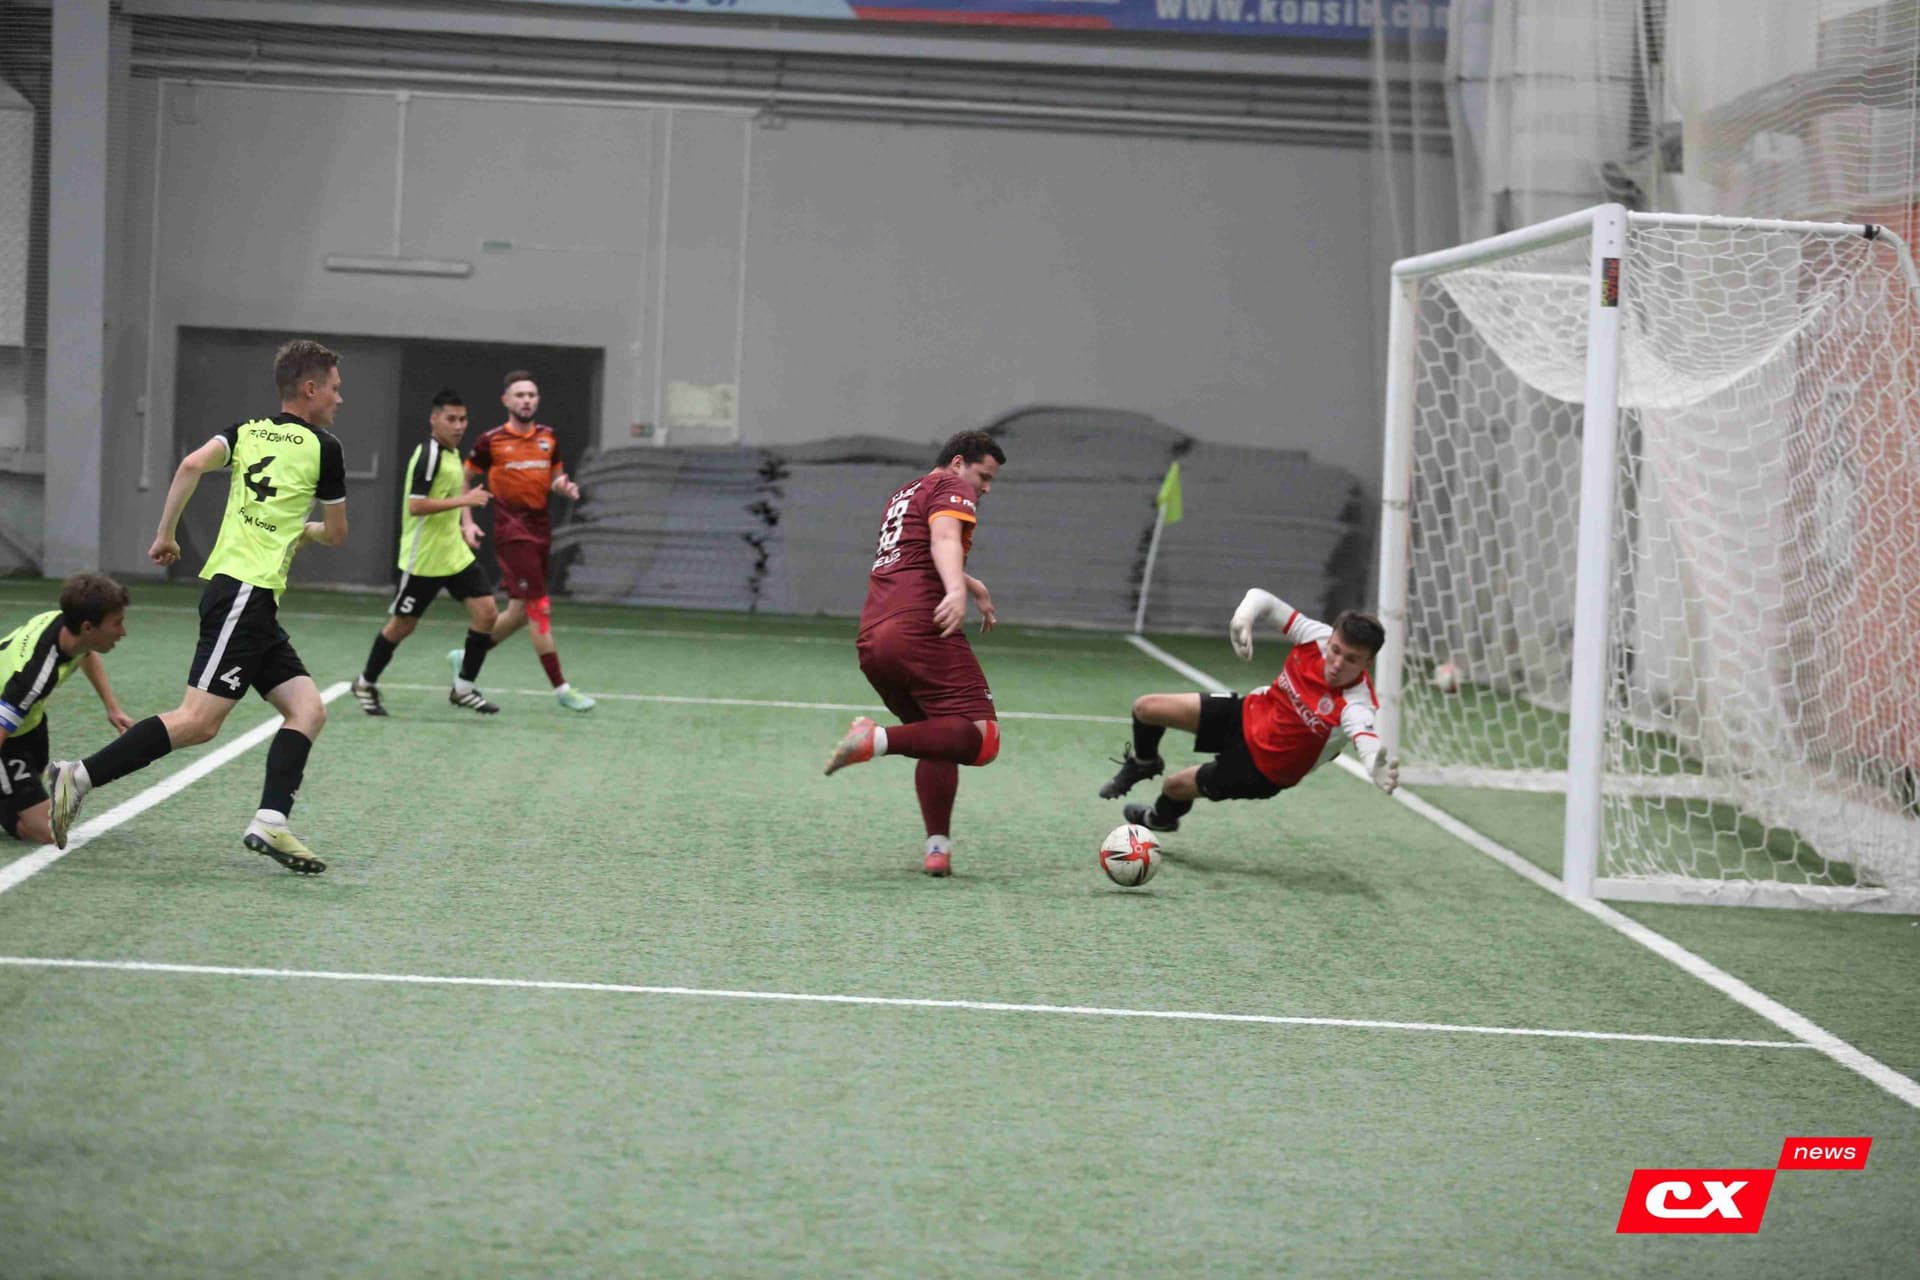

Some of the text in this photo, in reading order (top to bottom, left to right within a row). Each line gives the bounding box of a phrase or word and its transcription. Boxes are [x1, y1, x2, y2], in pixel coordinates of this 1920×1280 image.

[243, 456, 278, 503] 4
[400, 596, 416, 614] 5
[220, 665, 241, 691] 4
[8, 759, 31, 781] 2
